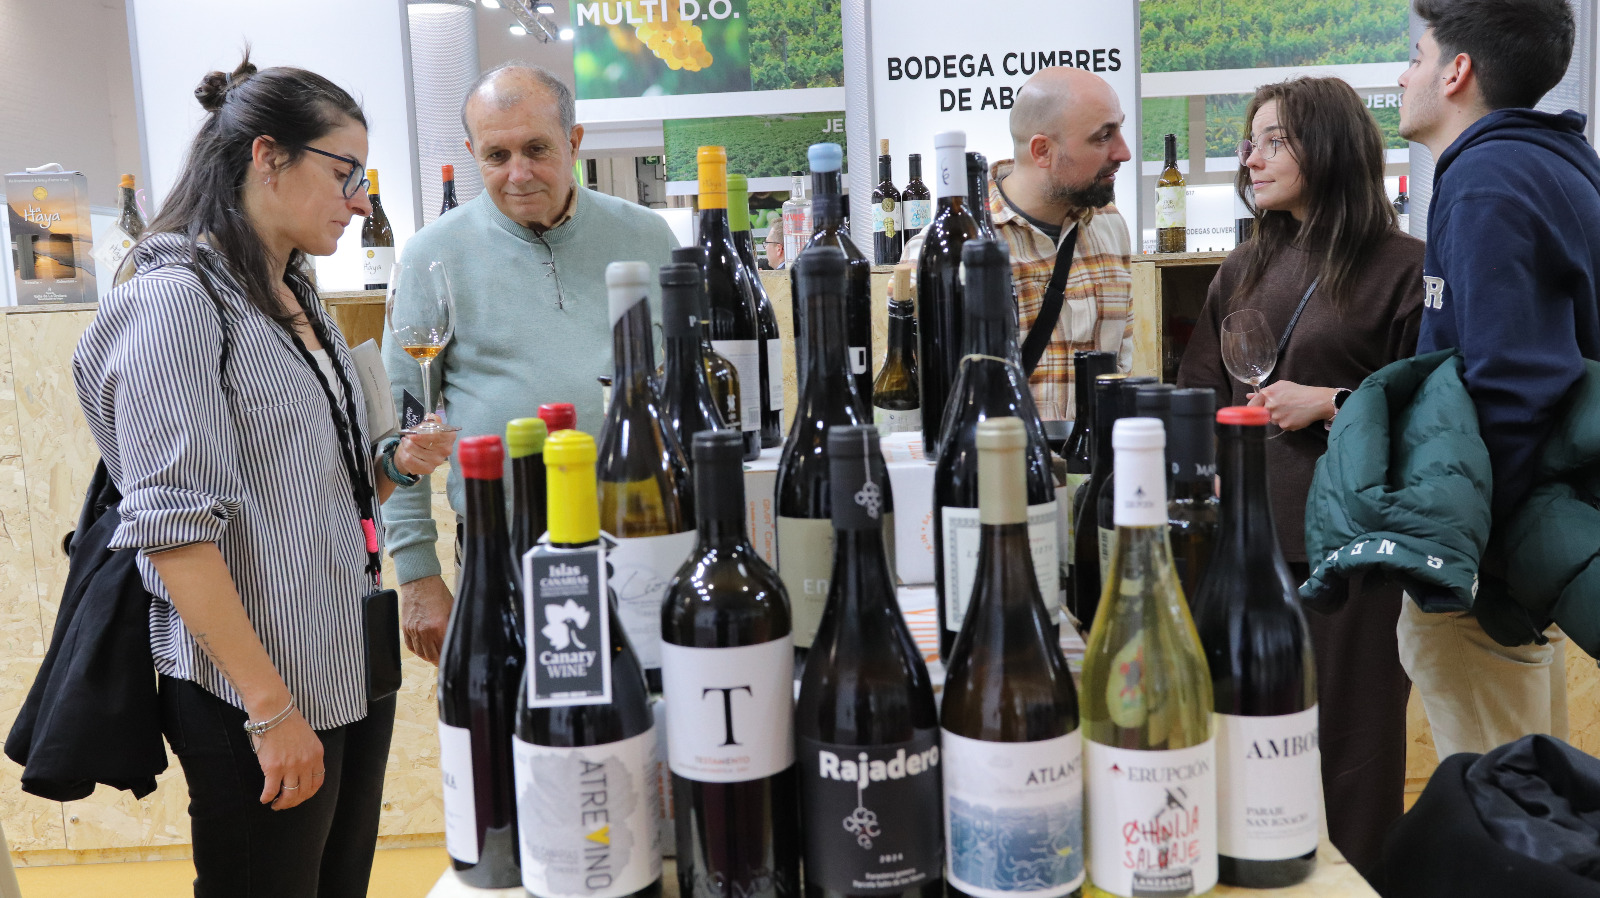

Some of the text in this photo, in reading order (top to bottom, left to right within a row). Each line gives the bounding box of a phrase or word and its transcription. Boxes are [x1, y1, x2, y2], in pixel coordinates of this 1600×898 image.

[576, 0, 740, 26] MULTI D.O.
[887, 48, 1122, 81] BODEGA CUMBRES
[939, 86, 1023, 112] DE AB
[24, 209, 61, 229] Haya
[548, 562, 581, 578] Islas
[539, 650, 596, 668] Canary
[546, 663, 588, 679] WINE
[703, 685, 752, 746] T
[818, 745, 939, 790] Rajadero
[1127, 758, 1210, 782] ERUPCIÓN
